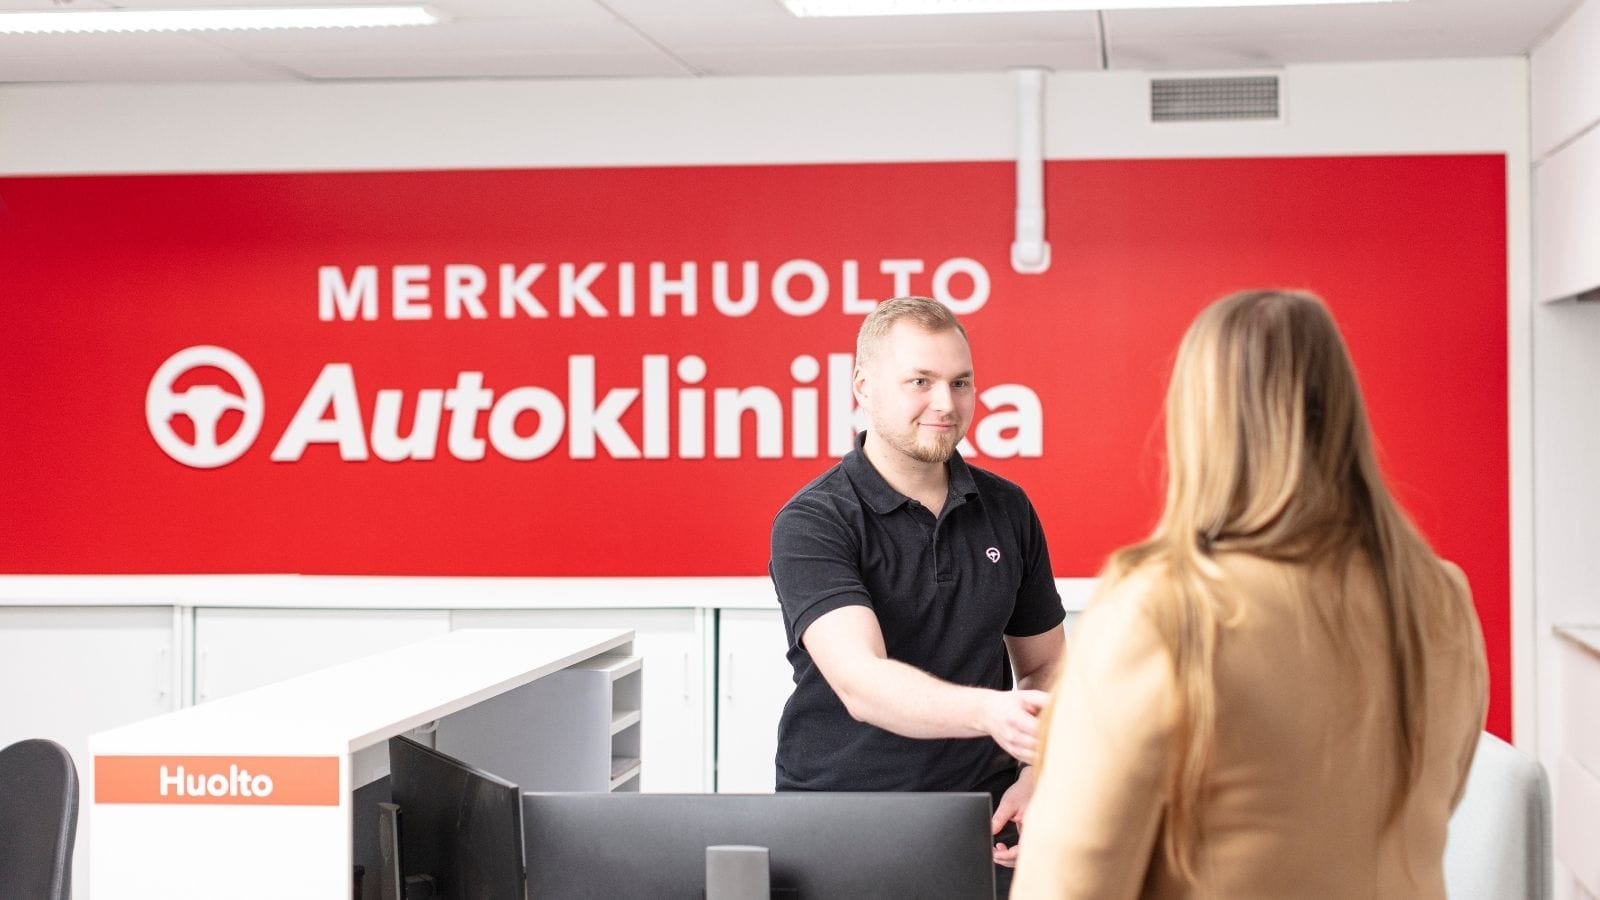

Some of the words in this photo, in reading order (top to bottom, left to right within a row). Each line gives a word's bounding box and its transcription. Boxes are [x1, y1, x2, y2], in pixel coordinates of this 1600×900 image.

[318, 257, 991, 321] MERKKIHUOLTO
[270, 354, 1044, 461] Autoklinika
[159, 765, 273, 797] Huolto
